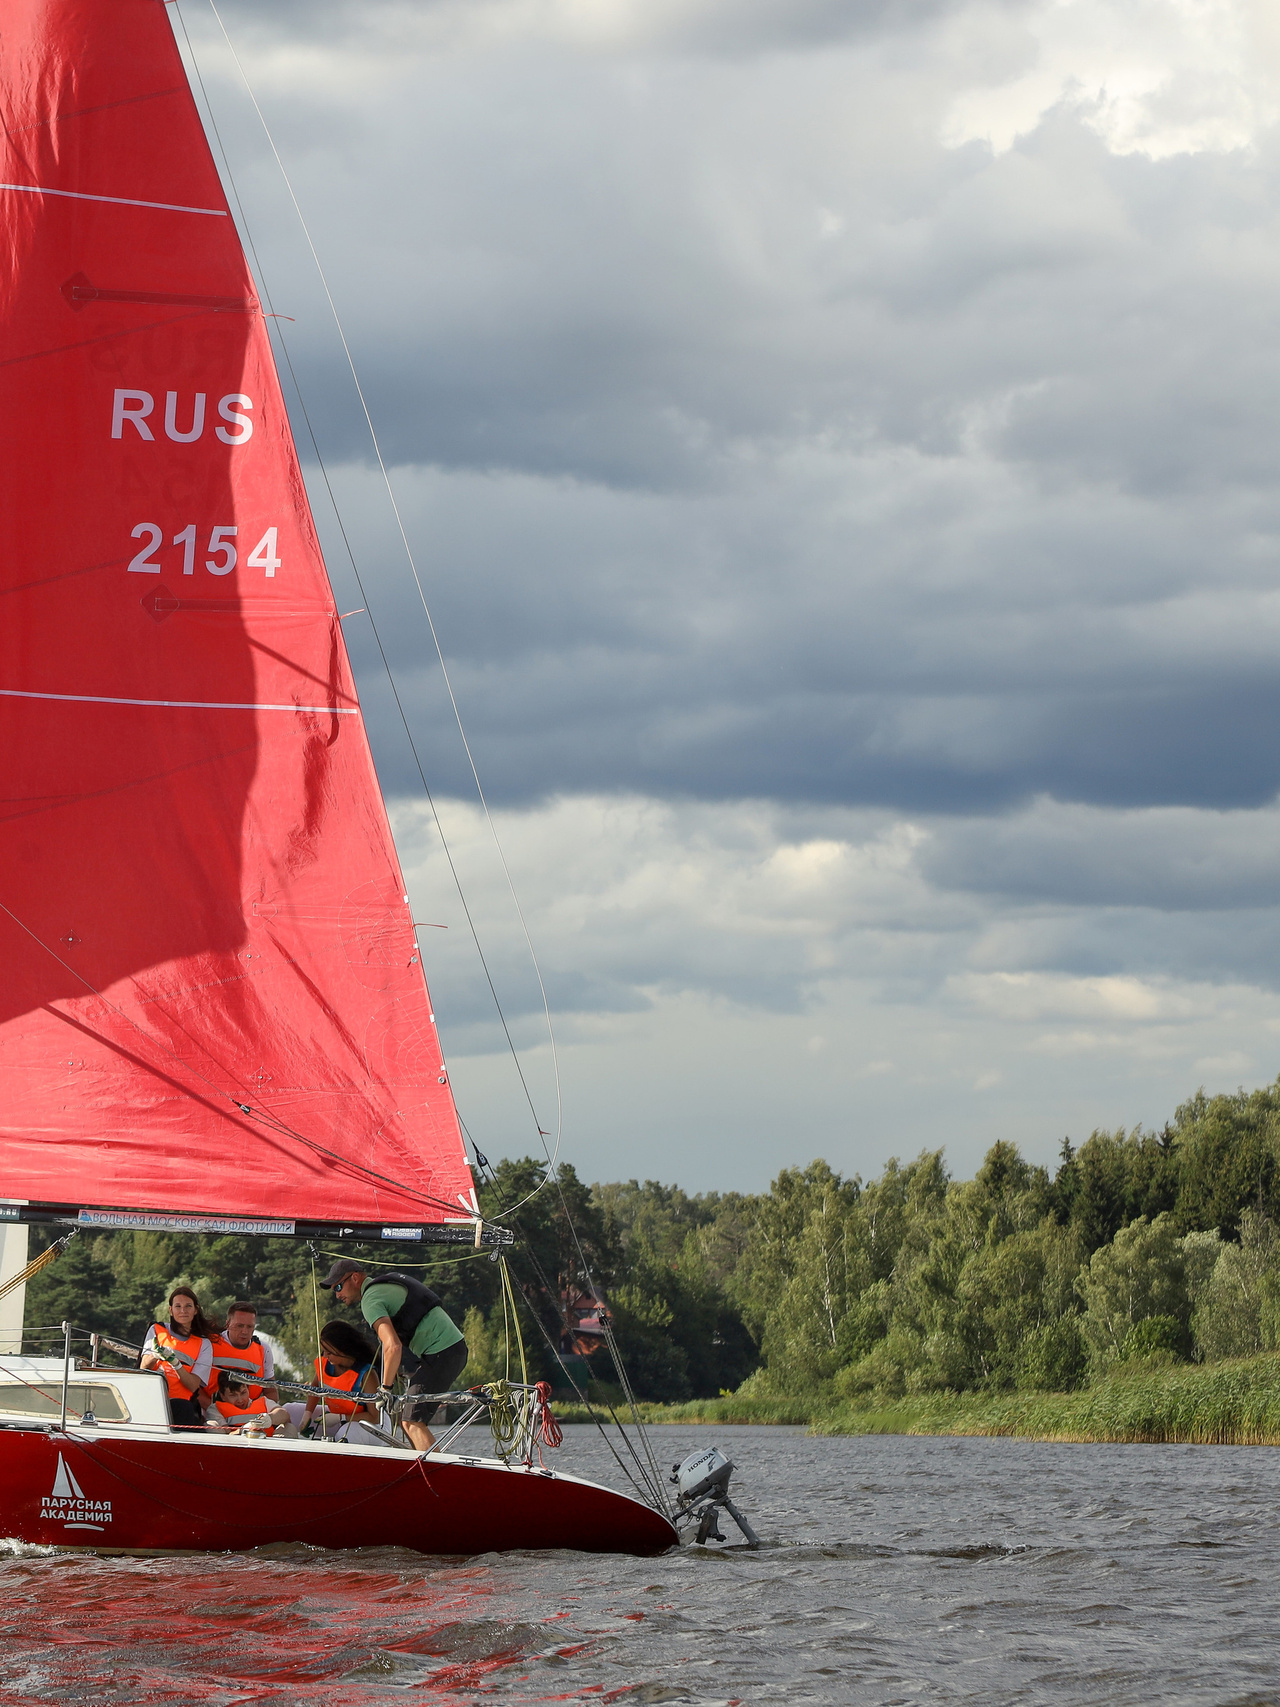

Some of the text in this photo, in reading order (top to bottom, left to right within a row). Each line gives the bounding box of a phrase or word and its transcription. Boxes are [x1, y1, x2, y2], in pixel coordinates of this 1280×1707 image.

[111, 388, 254, 446] RUS
[127, 522, 282, 578] 2154
[93, 1213, 292, 1233] ВОЛЬНАЯ МОСКОВСКАЯ ФЛОТИЛИЯ
[687, 1452, 715, 1473] HONDA
[41, 1497, 112, 1511] ПАРУСНАЯ
[39, 1508, 113, 1522] АКАДЕМИЯ
